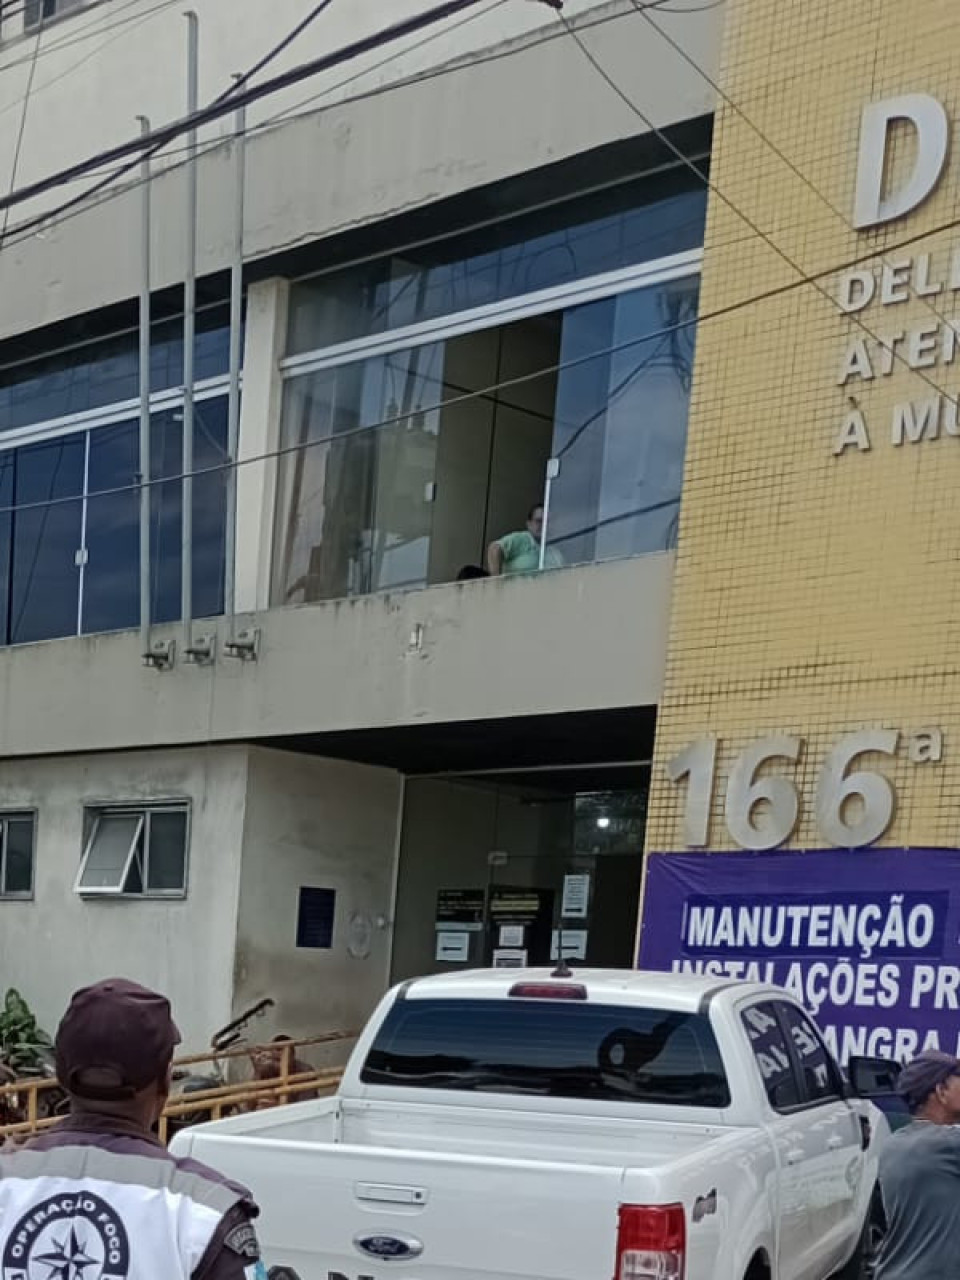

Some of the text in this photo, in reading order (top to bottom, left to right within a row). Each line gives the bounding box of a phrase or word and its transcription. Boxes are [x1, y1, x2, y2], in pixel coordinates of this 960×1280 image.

[840, 251, 960, 315] DEL
[833, 396, 872, 458] À
[687, 893, 935, 959] MANUTENÇÃO
[910, 964, 960, 1009] PR
[97, 1211, 121, 1265] FOCO
